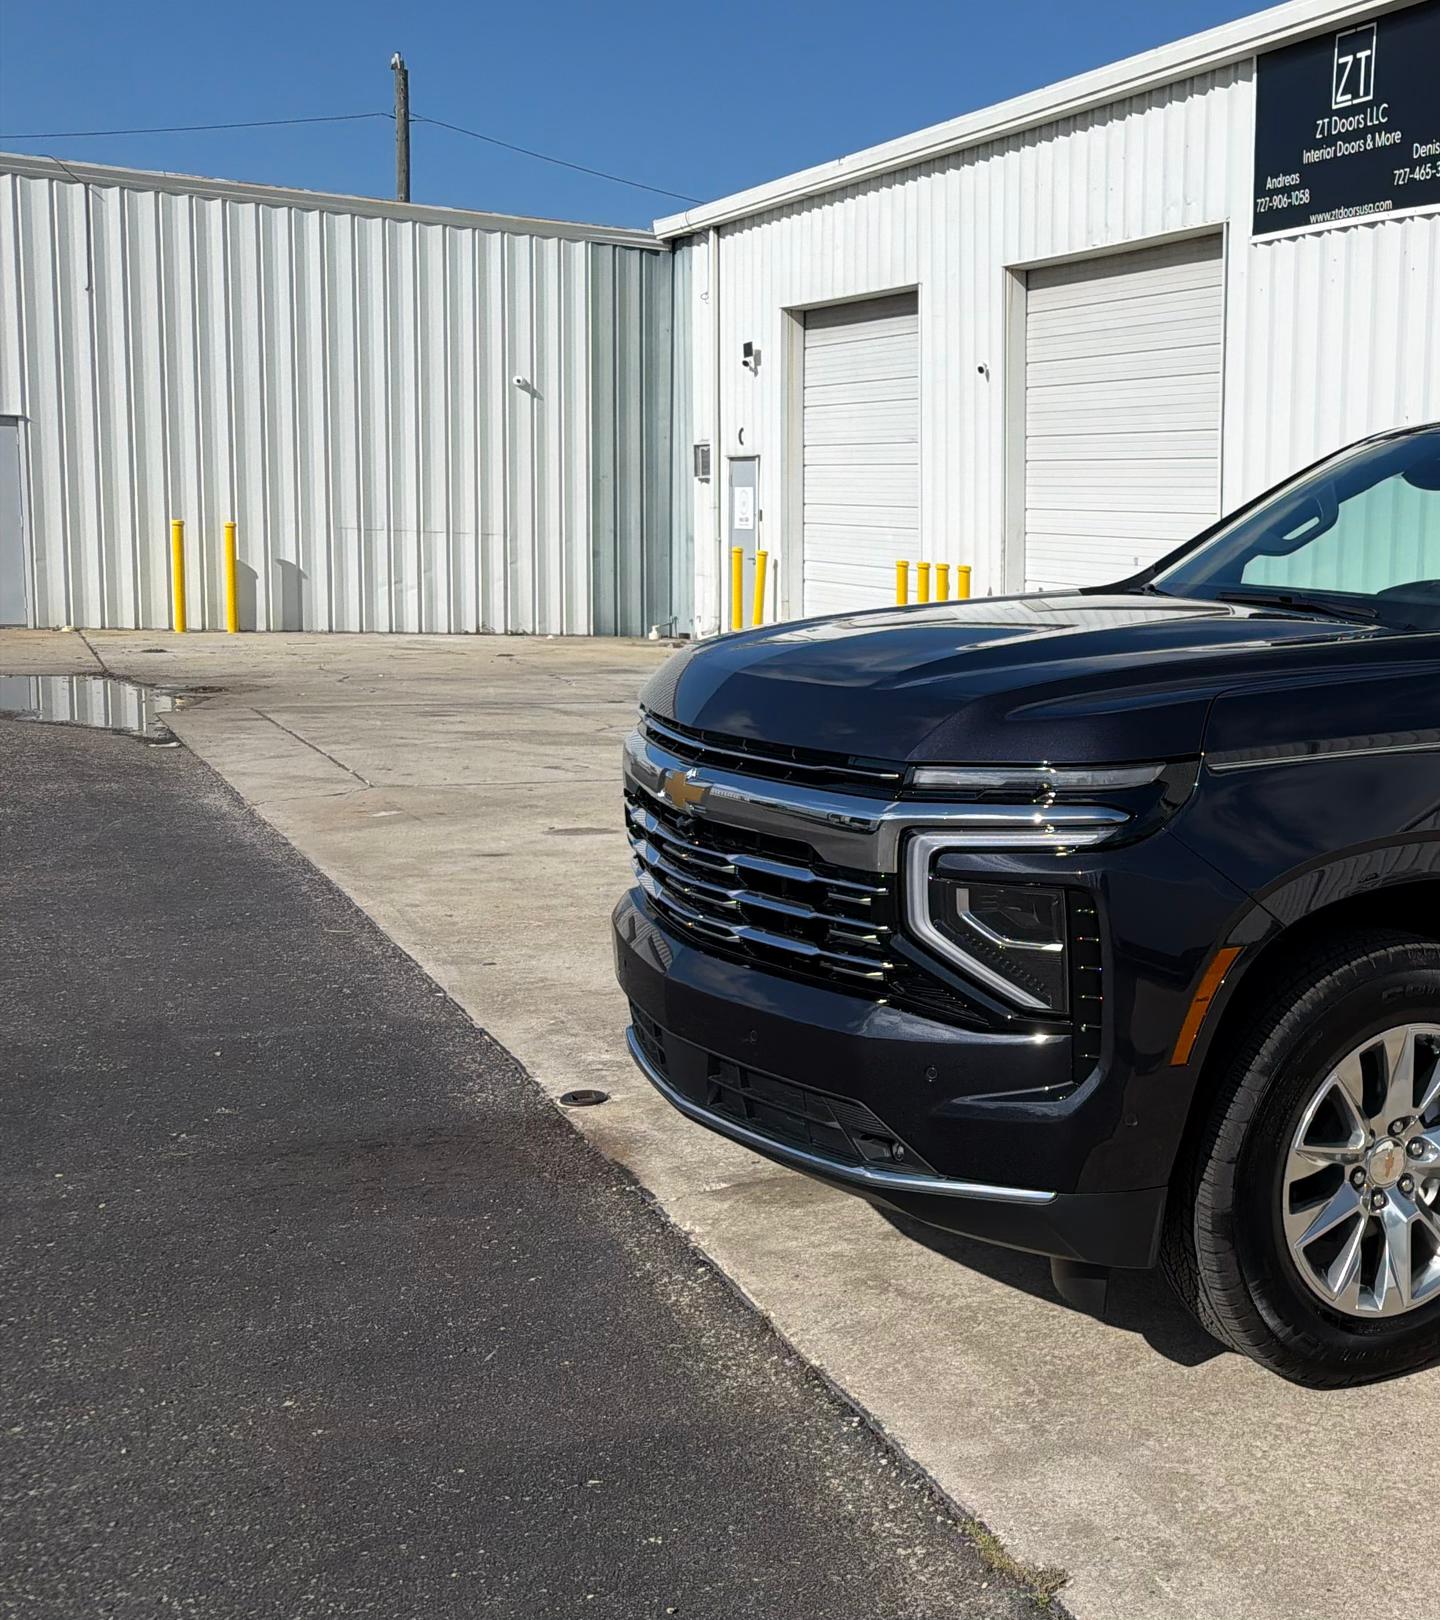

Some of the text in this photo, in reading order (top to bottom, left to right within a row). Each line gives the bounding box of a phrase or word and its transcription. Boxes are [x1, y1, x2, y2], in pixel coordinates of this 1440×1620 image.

[1336, 50, 1371, 102] ZT
[1315, 103, 1389, 139] ZT Doors LLC
[1303, 130, 1402, 165] Interior Doors & More
[1413, 139, 1440, 159] Denis
[1265, 172, 1300, 190] Andreas
[1256, 188, 1310, 213] 727-906-1058
[1309, 199, 1393, 224] www.ztdoorsusa.com
